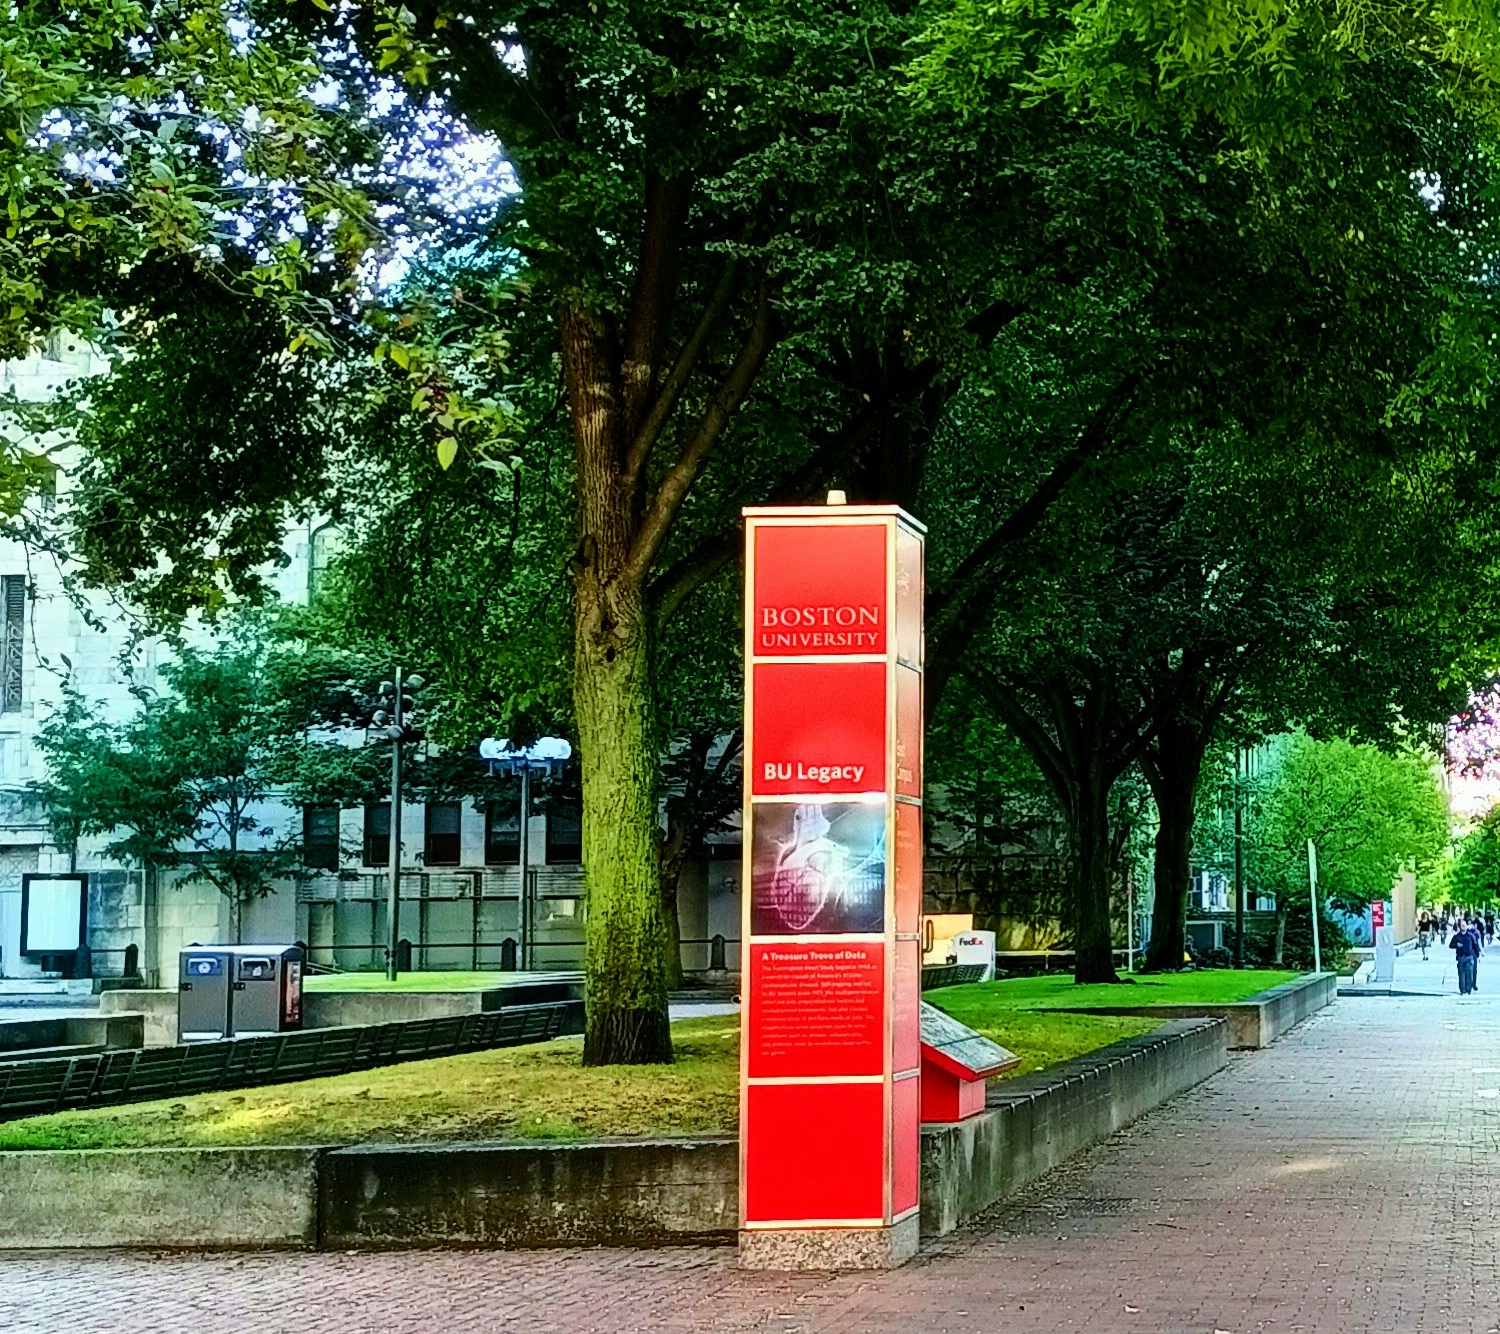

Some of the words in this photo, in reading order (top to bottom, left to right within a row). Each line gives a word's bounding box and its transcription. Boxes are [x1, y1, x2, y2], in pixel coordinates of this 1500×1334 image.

[762, 607, 879, 626] BOSTON
[762, 632, 879, 647] UNIVERSITY
[764, 763, 792, 780] BU
[797, 762, 864, 784] Legacy
[959, 937, 983, 946] FedEx
[762, 953, 769, 961] A
[770, 952, 808, 961] Treasure
[809, 951, 834, 960] Trove
[835, 951, 844, 959] of
[845, 950, 867, 959] Data
